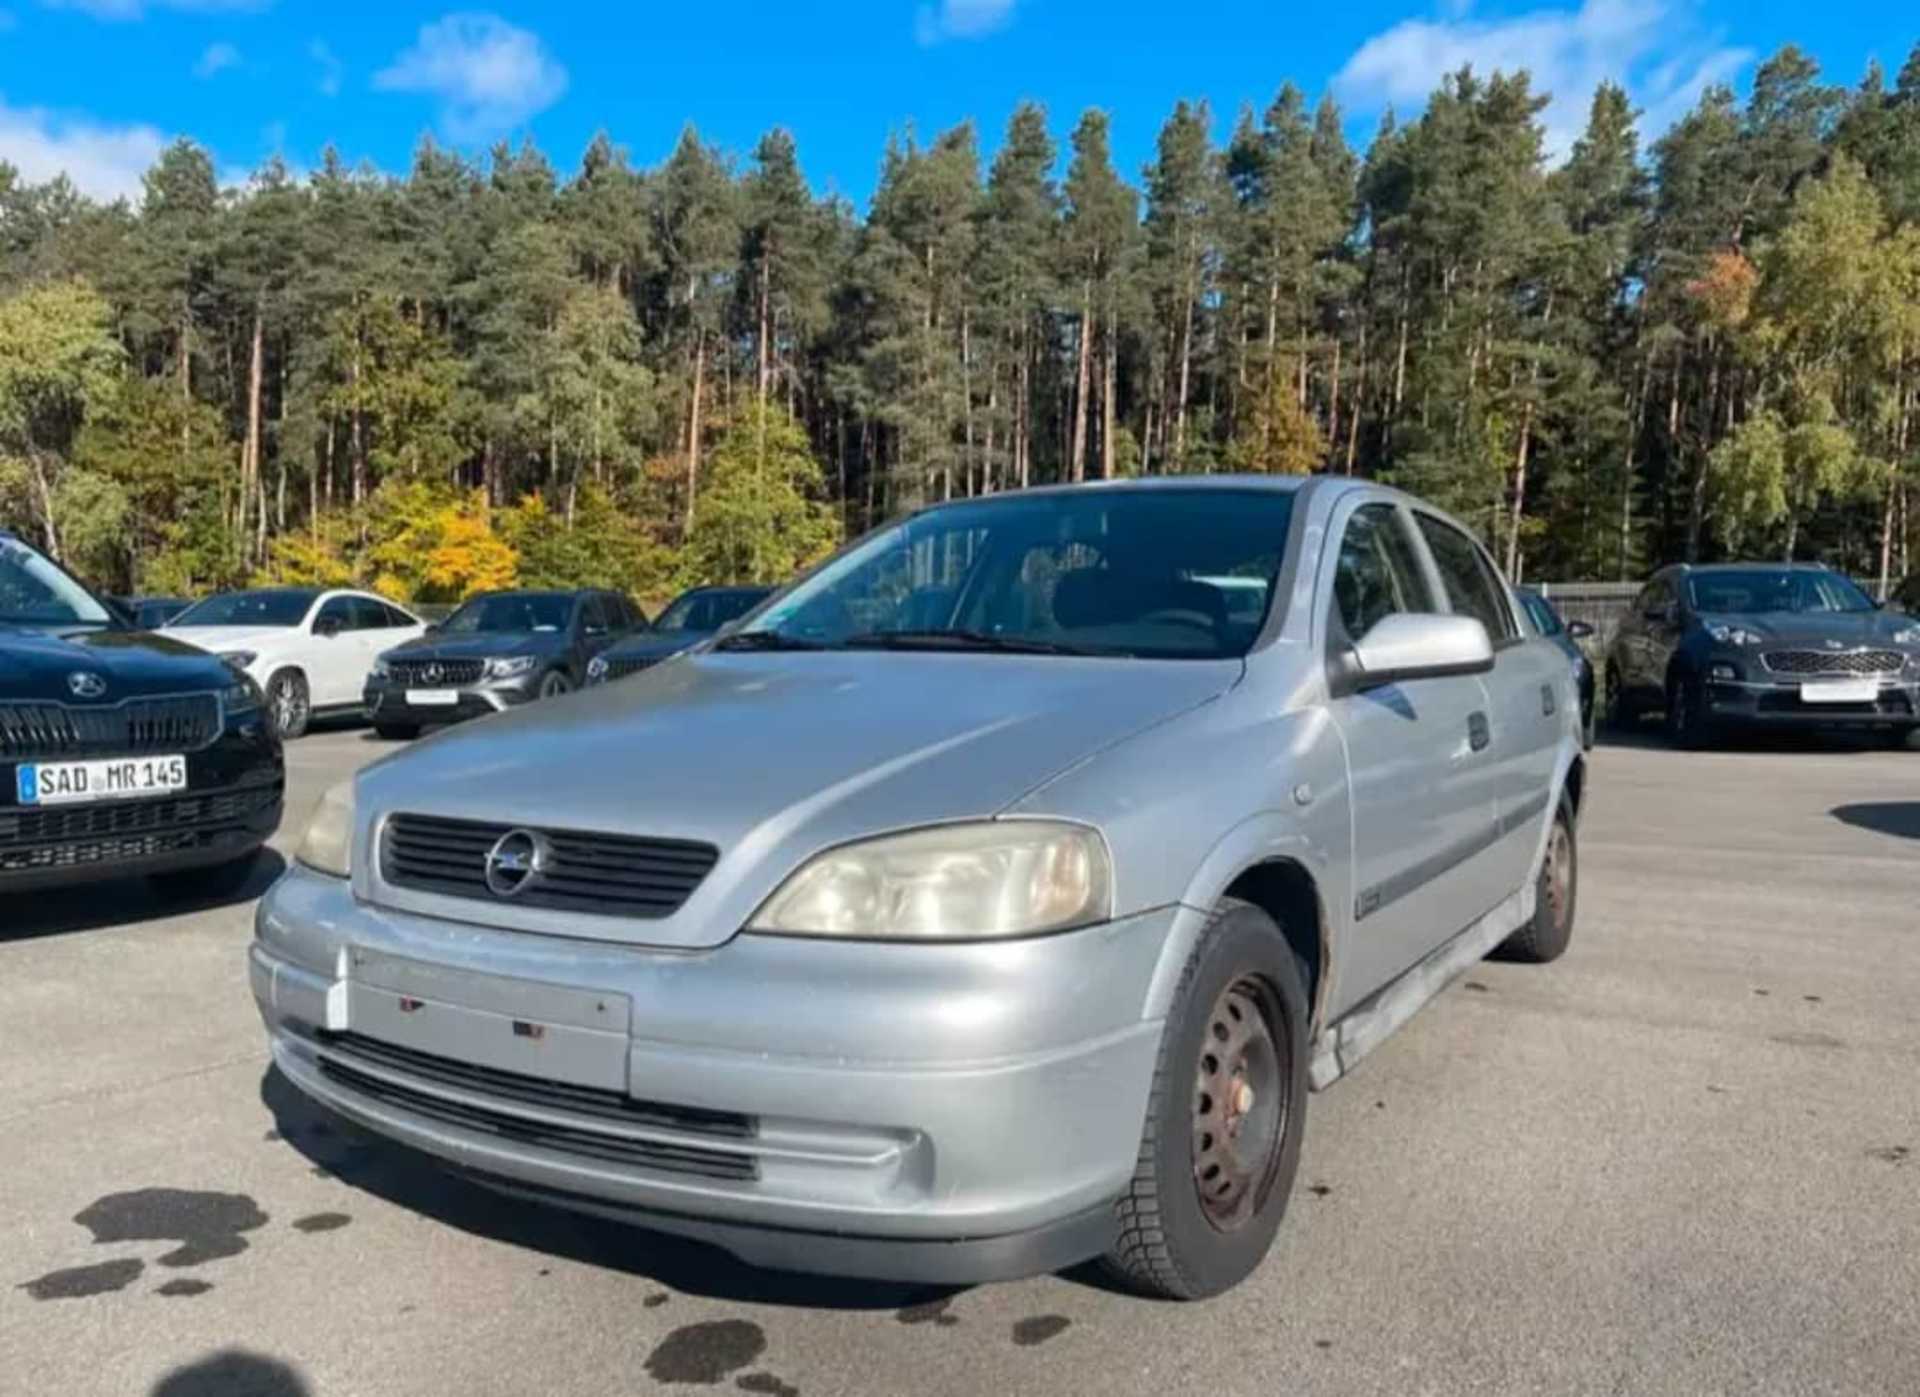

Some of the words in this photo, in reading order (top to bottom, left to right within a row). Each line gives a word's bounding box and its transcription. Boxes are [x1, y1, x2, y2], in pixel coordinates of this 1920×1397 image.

[39, 767, 88, 794] SAD
[107, 763, 137, 789] MR
[143, 760, 183, 787] 145
